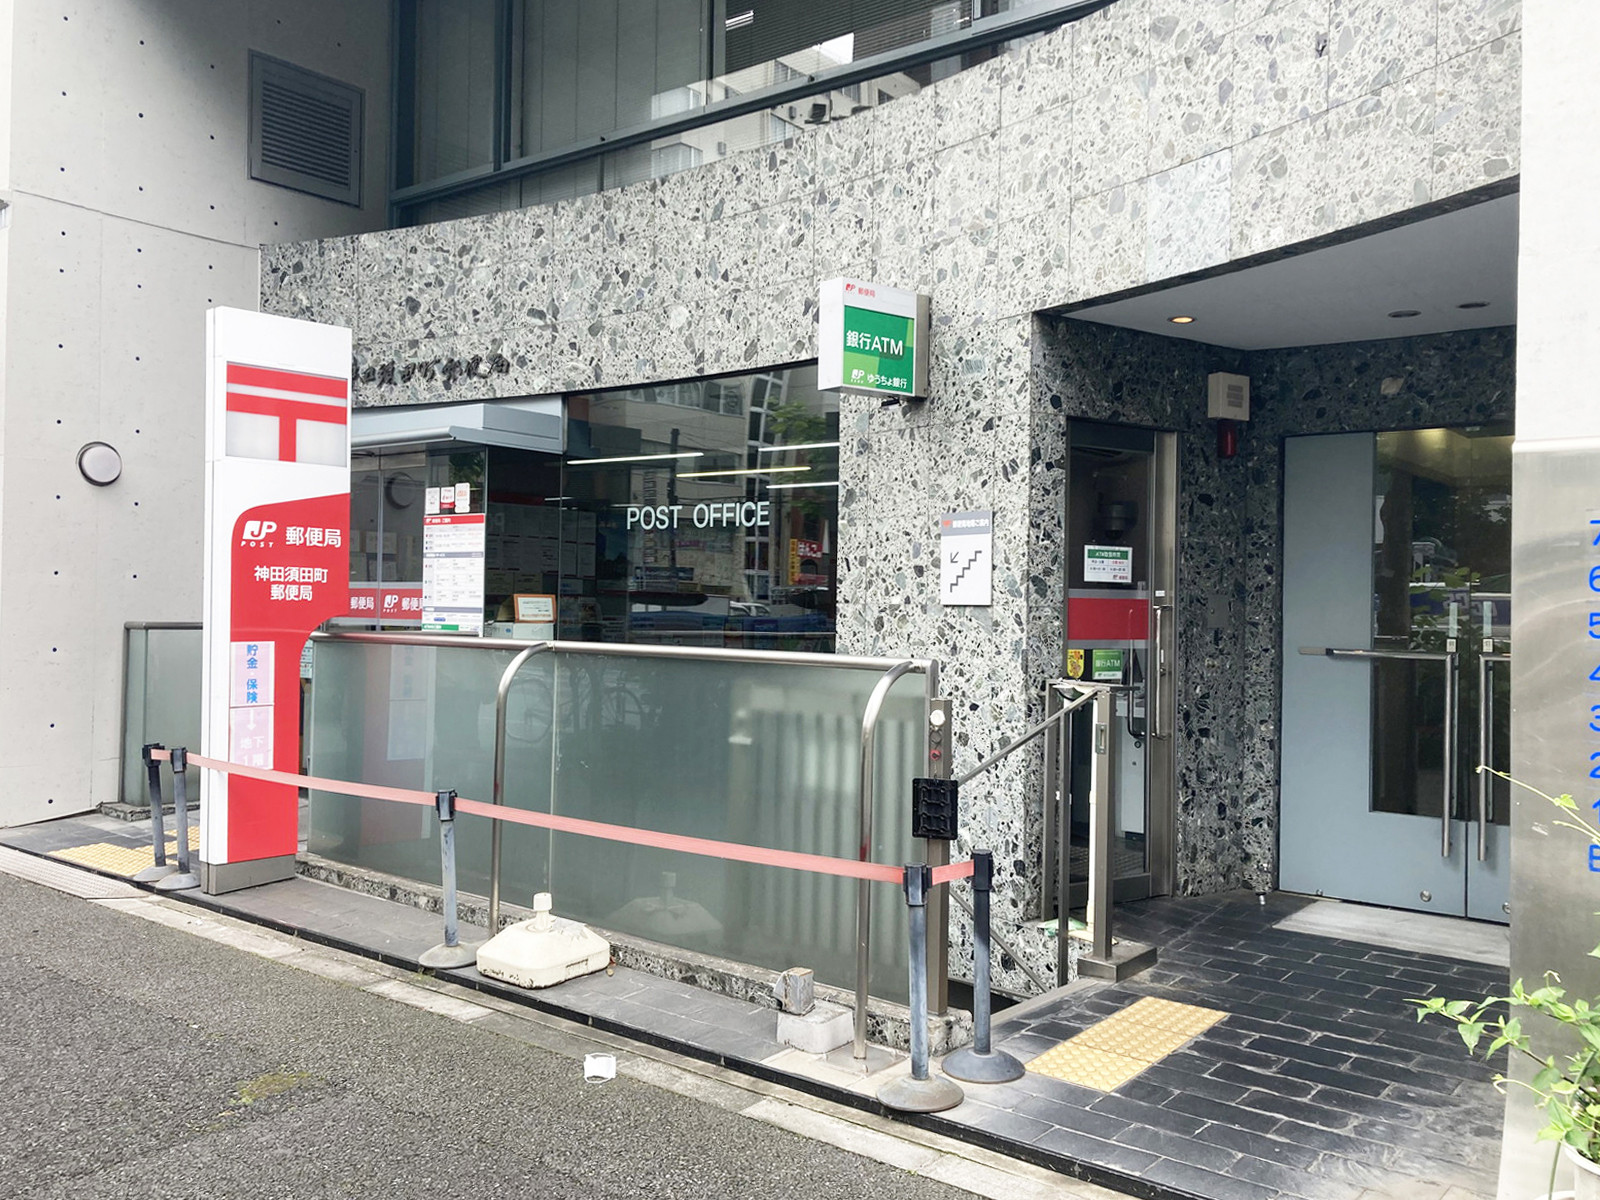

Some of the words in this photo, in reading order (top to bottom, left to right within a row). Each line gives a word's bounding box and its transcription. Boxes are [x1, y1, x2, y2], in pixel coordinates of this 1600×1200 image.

[846, 330, 903, 356] 銀行ATM
[867, 374, 907, 389] ゆうちょ銀行
[627, 506, 682, 530] POST
[693, 501, 770, 528] OFFICE
[240, 540, 274, 548] POST
[286, 526, 341, 548] 郵便局
[254, 565, 328, 583] 神田須田町
[270, 584, 313, 601] 郵便局
[350, 596, 375, 610] 郵便局
[401, 597, 423, 611] 郵便
